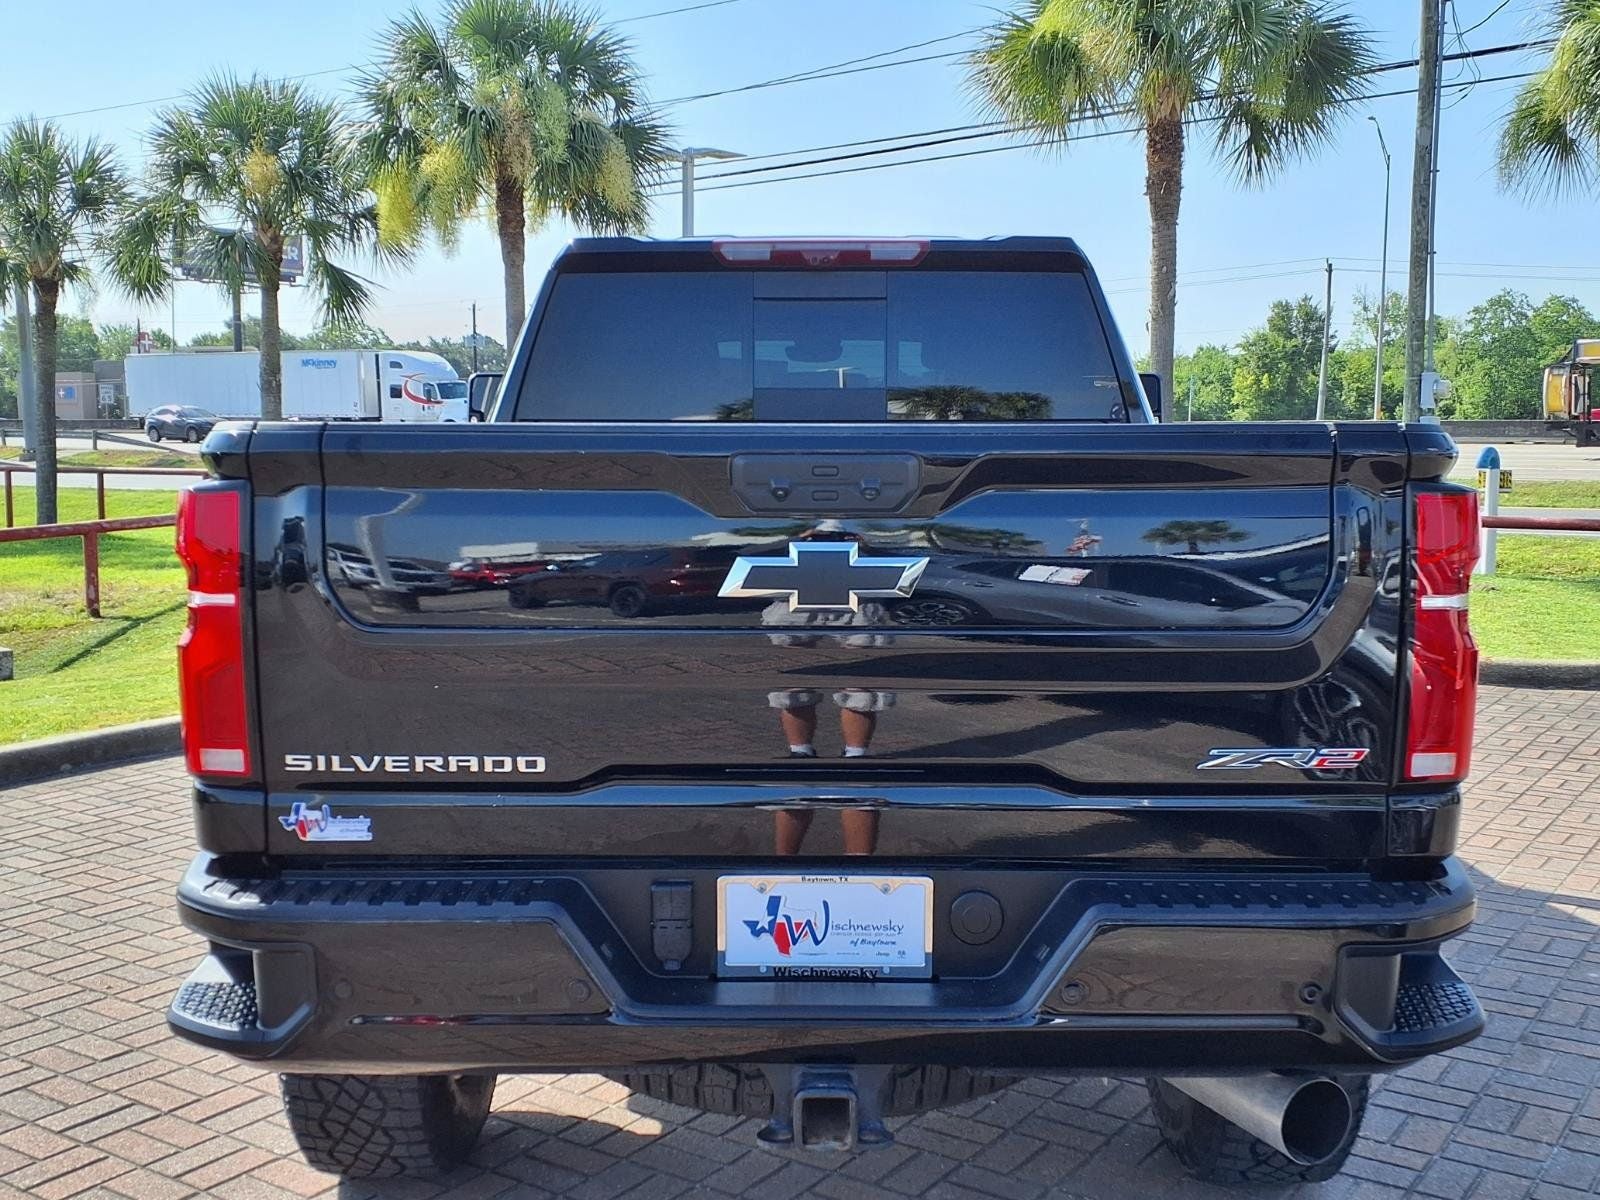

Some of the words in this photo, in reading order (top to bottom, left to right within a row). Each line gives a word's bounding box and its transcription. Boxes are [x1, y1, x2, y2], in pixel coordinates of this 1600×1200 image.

[284, 754, 547, 773] SILVERADO
[1197, 748, 1370, 770] ZR2
[782, 900, 904, 946] Wischnewsky
[850, 938, 859, 946] of
[773, 966, 878, 979] Wischnewsky
